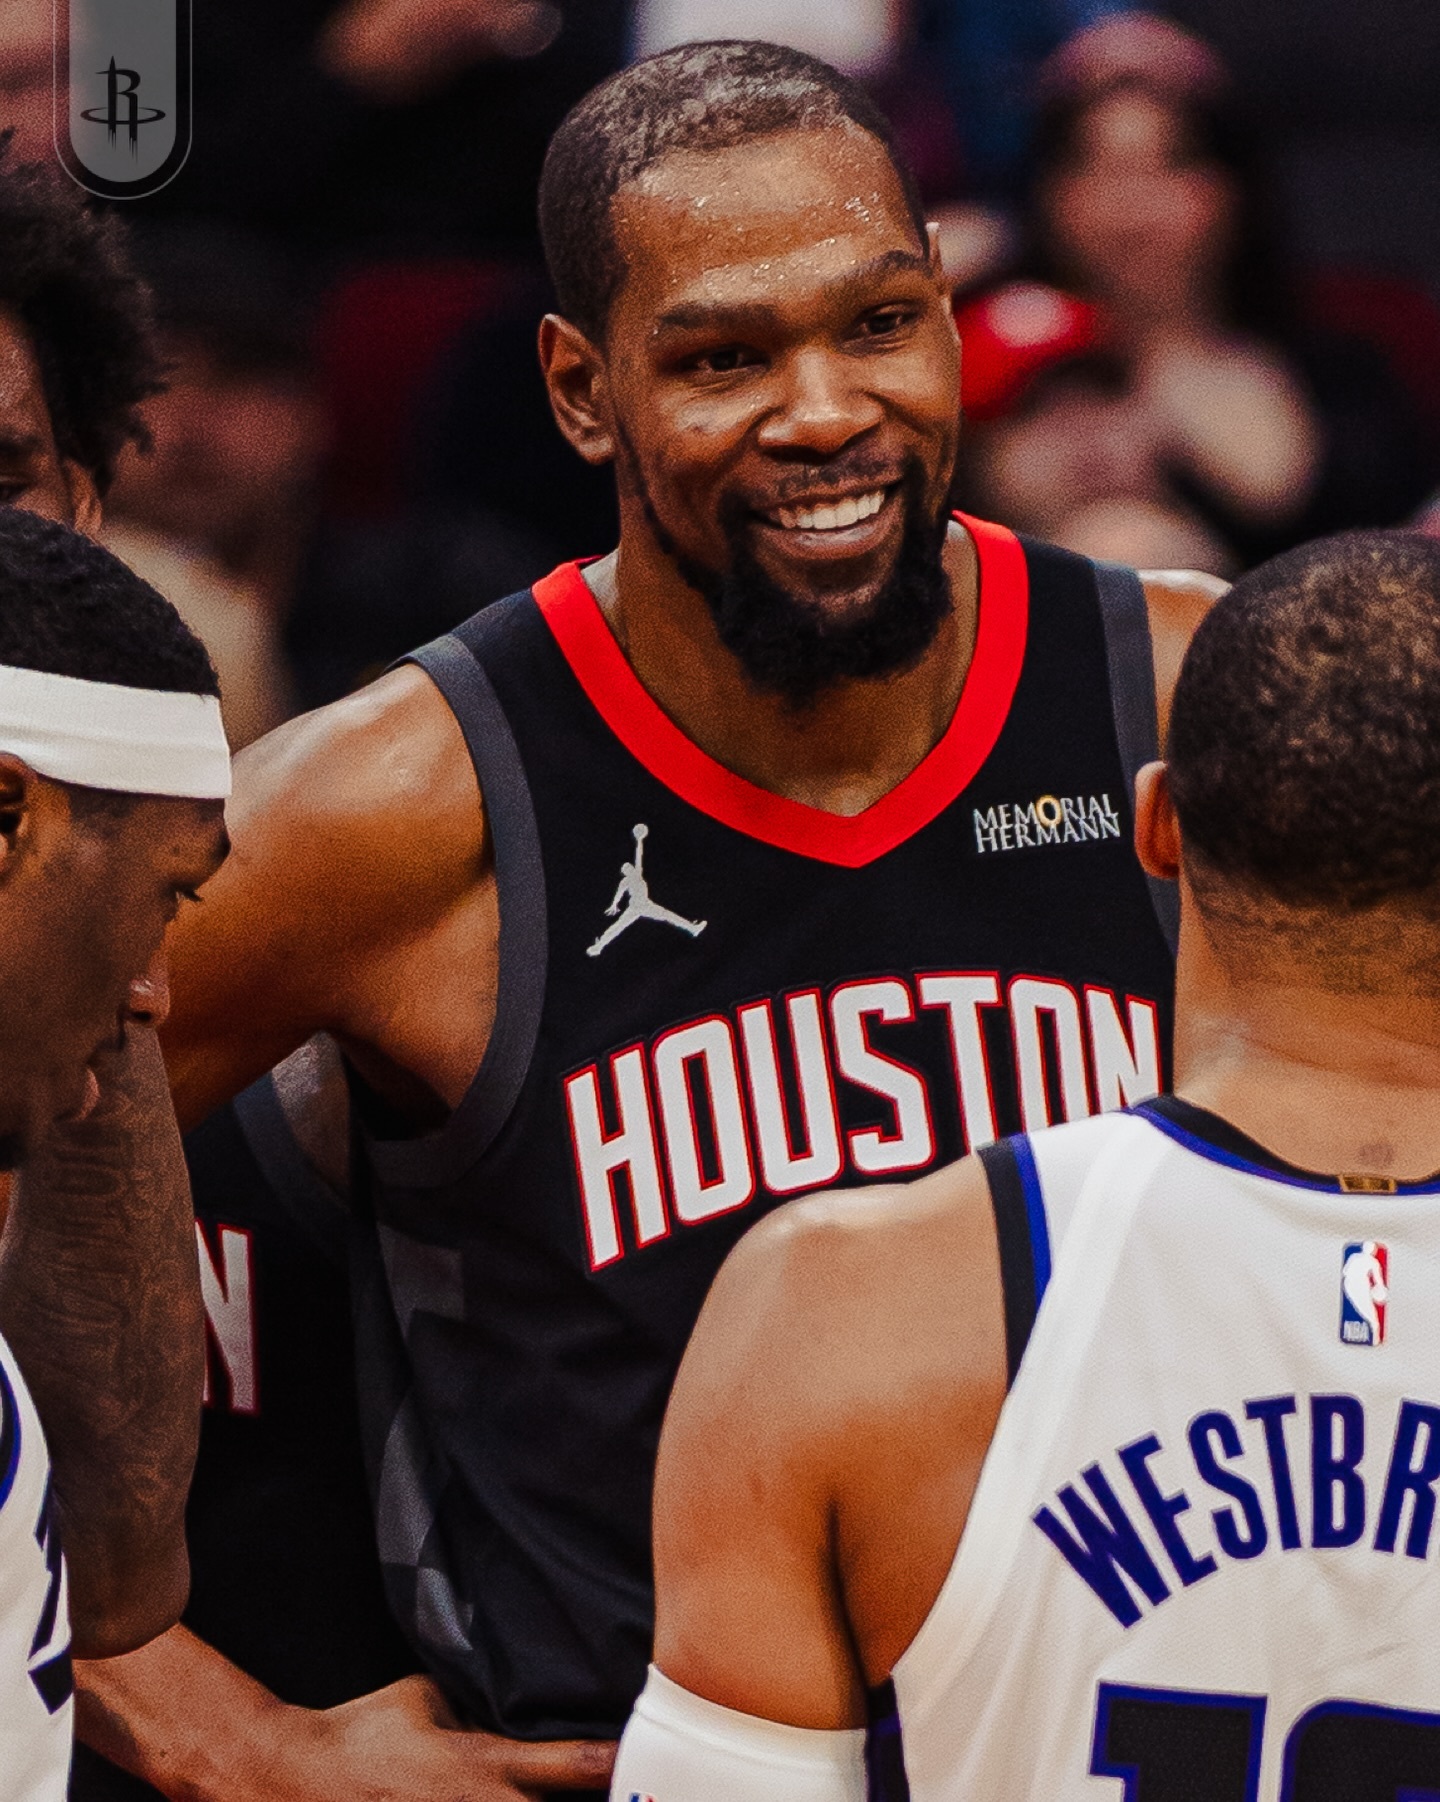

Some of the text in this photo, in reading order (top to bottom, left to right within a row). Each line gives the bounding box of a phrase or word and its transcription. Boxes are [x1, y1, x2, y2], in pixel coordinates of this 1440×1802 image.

[973, 794, 1119, 829] MEMORIAL
[975, 814, 1121, 853] HERMANN
[563, 969, 1164, 1273] HOUSTON
[1343, 1319, 1371, 1342] NBA
[1032, 1392, 1440, 1630] WESTBR
